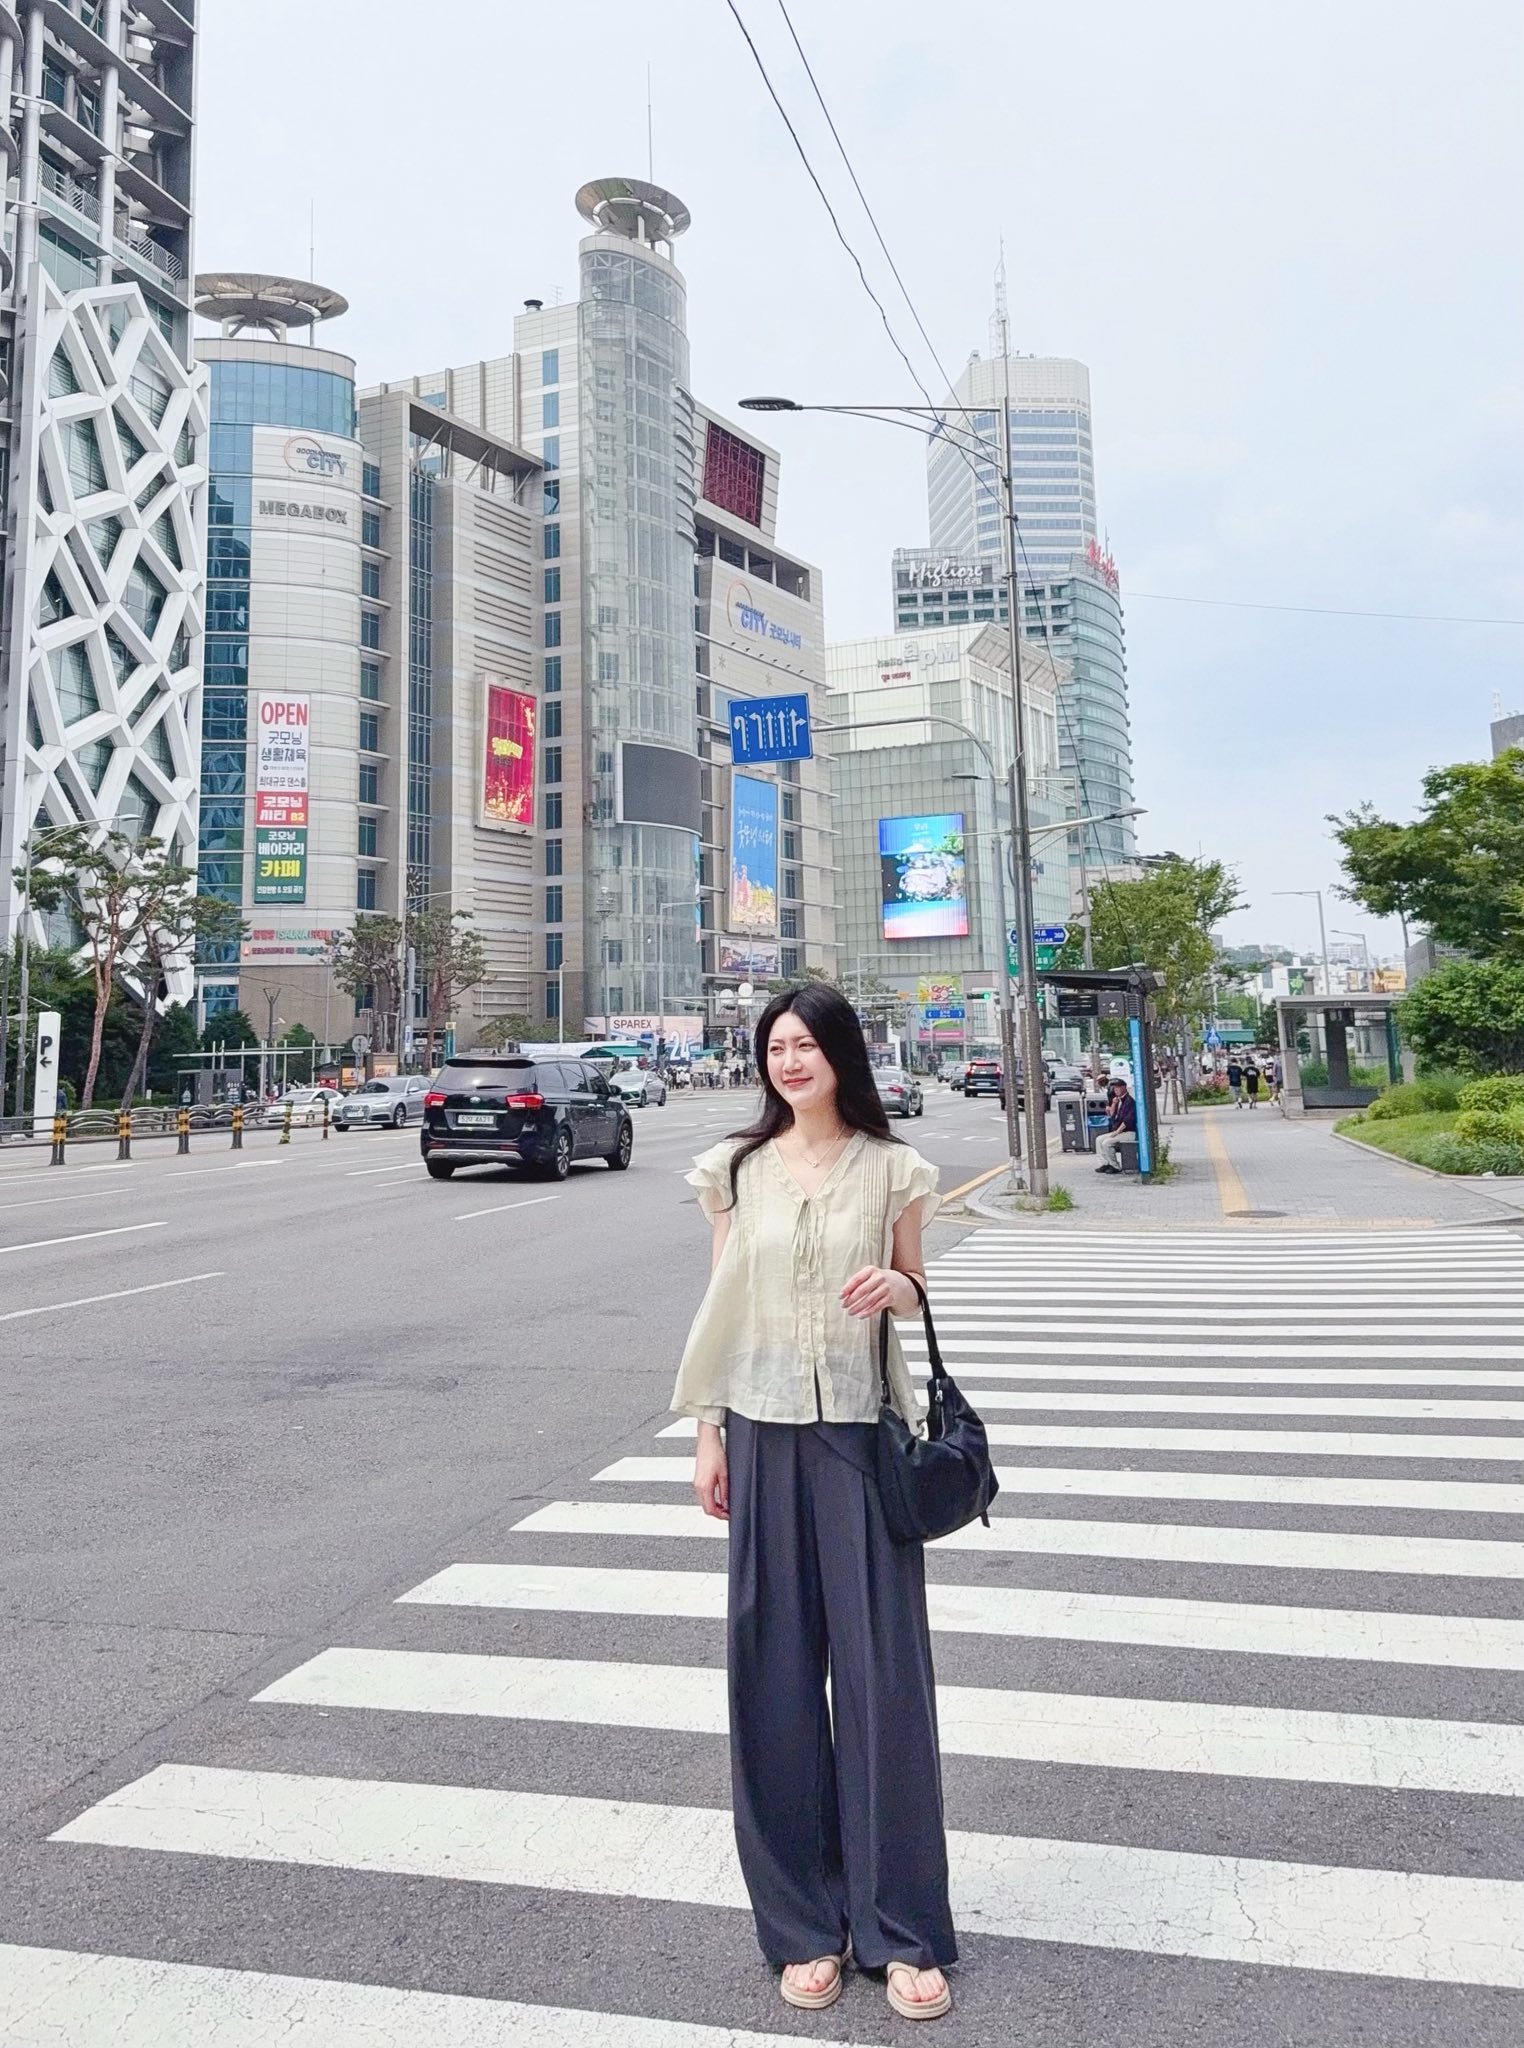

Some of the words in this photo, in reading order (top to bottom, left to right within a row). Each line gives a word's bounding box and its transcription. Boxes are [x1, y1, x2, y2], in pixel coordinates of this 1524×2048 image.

[306, 453, 348, 475] CITY
[259, 500, 347, 525] MEGABOX
[908, 558, 983, 587] Migliore
[740, 609, 769, 636] CITY
[261, 701, 308, 726] OPEN
[268, 730, 302, 745] 굿모닝
[261, 747, 306, 762] 생활체육
[263, 795, 303, 808] 굿모닝
[260, 809, 287, 821] 시티
[268, 831, 296, 841] 굿모닝
[257, 842, 305, 856] 베이커리
[260, 860, 301, 878] 카페
[613, 1019, 653, 1030] SPAREX
[40, 1035, 53, 1056] P
[669, 1030, 691, 1062] 24
